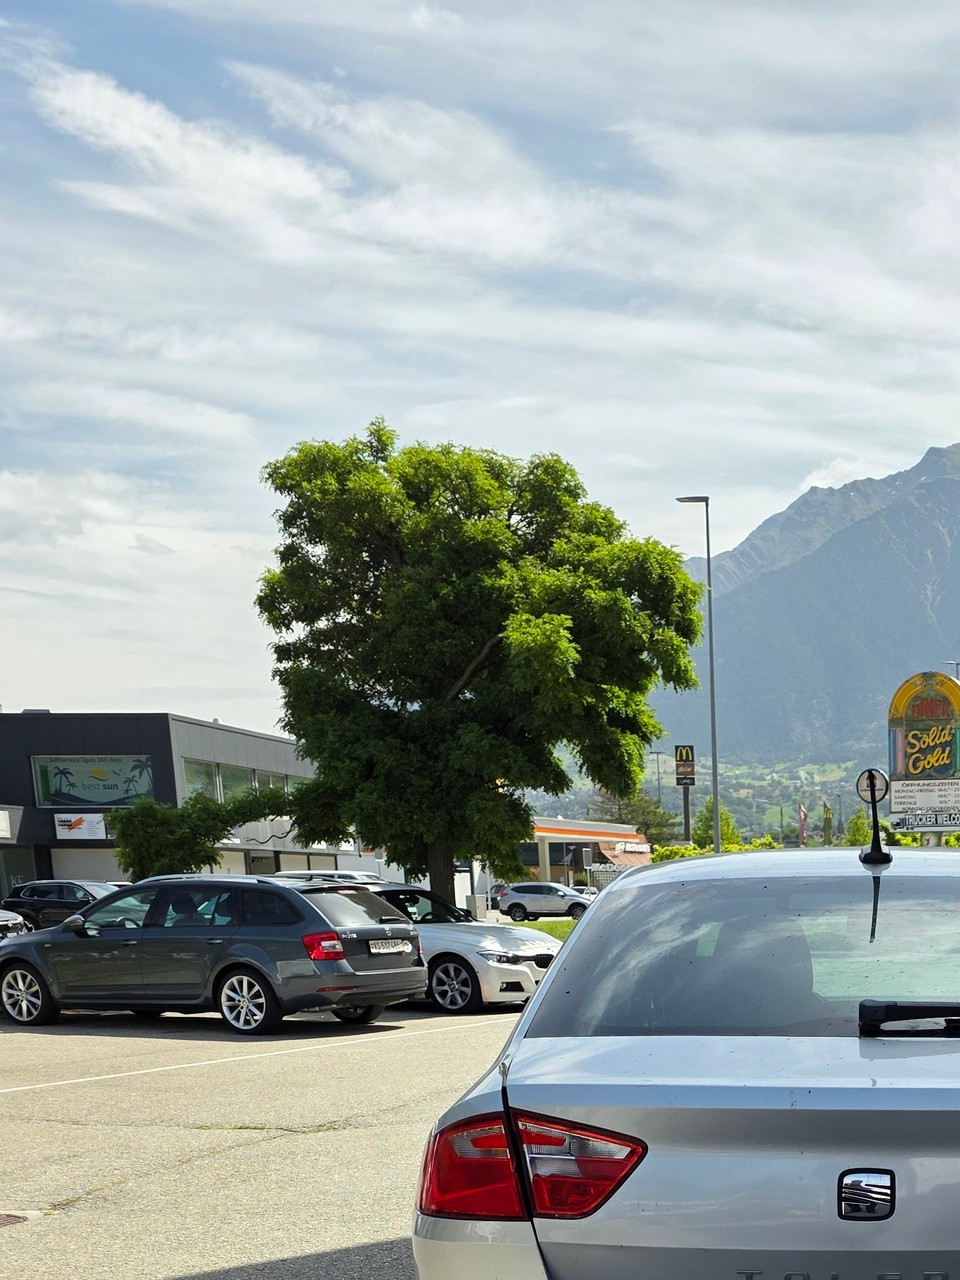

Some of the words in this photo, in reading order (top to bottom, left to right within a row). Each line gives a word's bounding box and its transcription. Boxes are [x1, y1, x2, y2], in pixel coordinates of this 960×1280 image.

[906, 725, 953, 753] Solid
[909, 747, 952, 775] Gold
[81, 781, 100, 790] best
[905, 814, 936, 825] TRUCKER
